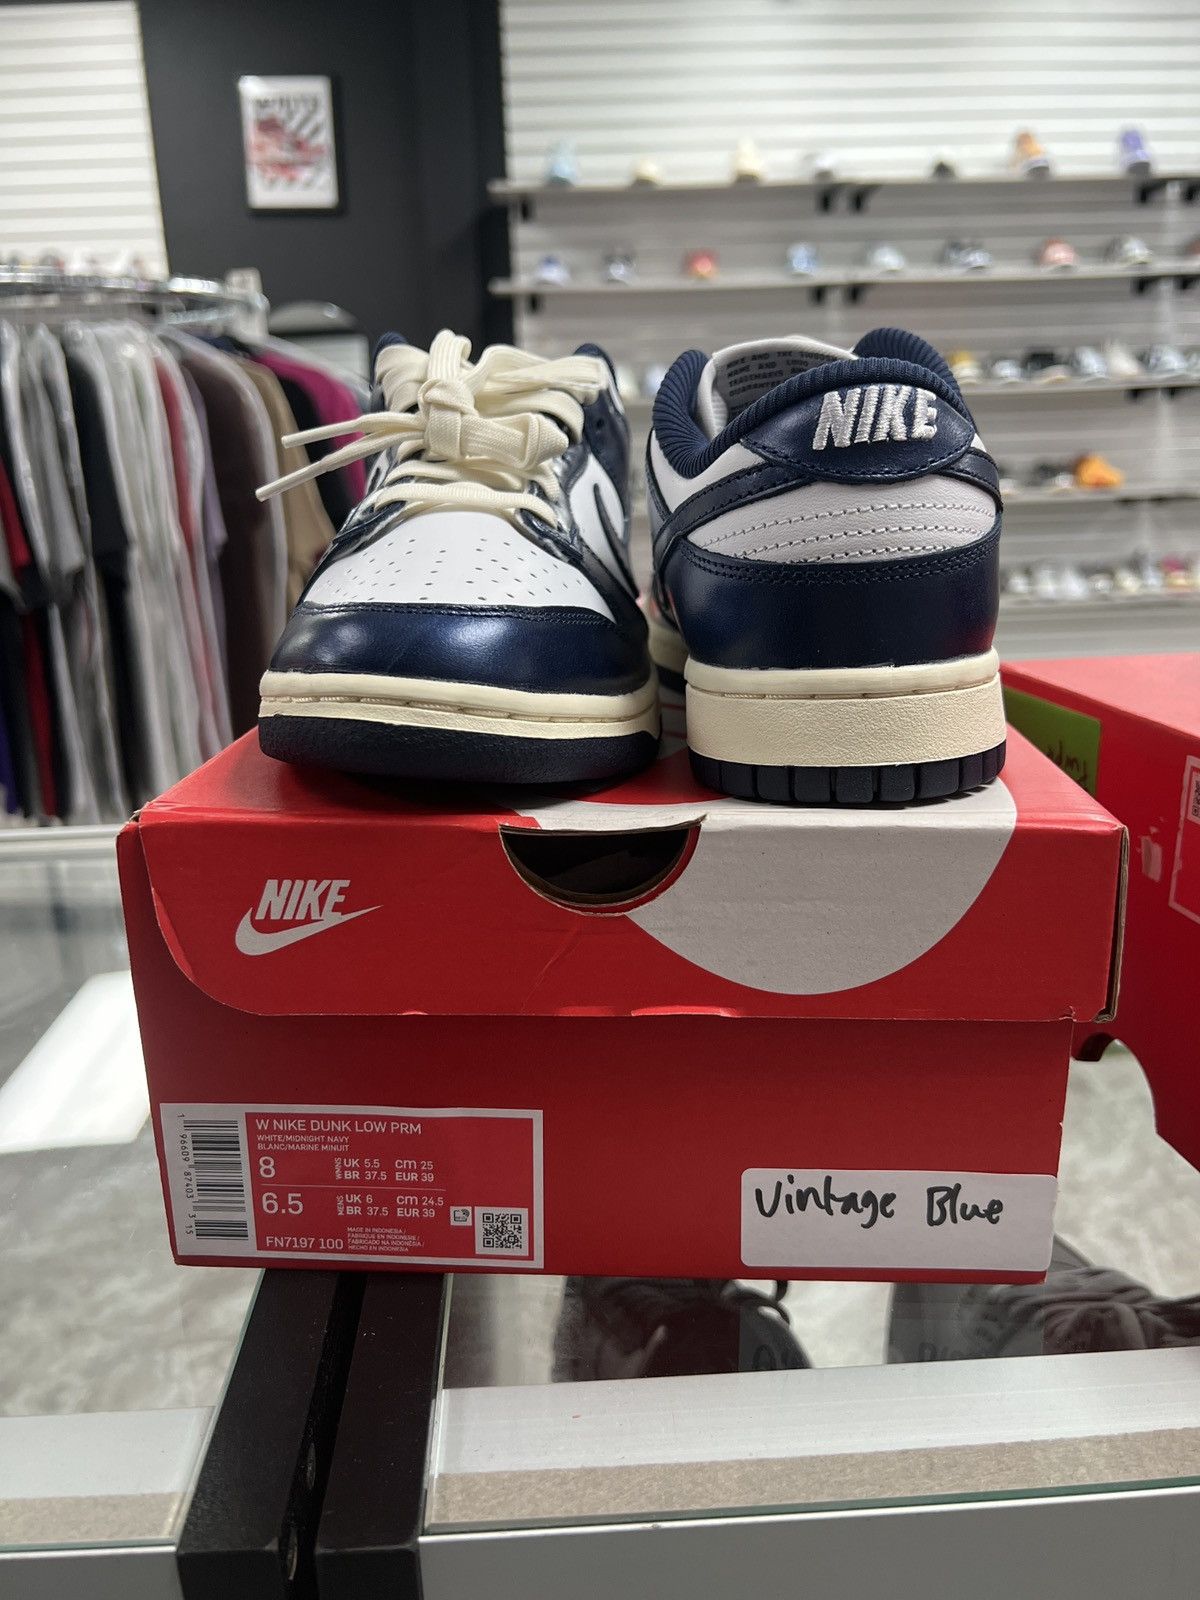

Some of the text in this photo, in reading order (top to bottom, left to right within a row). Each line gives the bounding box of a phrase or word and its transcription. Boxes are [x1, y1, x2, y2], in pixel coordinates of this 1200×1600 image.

[812, 383, 938, 451] NIKE
[255, 879, 351, 921] NIKE
[256, 1118, 422, 1135] W NIKE DUNK LOW PRM
[180, 1133, 190, 1162] 96609
[257, 1134, 350, 1144] WHITE/MIDNIGHT NAVY
[257, 1143, 350, 1152] BLANC/MARINE MINUIT
[259, 1156, 276, 1178] 8
[344, 1158, 360, 1168] UK
[364, 1158, 380, 1169] 5.5
[420, 1160, 434, 1170] 25
[344, 1170, 435, 1182] BR 37.5 EUR 39
[184, 1171, 194, 1199] 87403
[262, 1192, 304, 1215] 6.5
[345, 1194, 361, 1204] UK
[366, 1194, 373, 1204] 6
[421, 1196, 444, 1206] 24.5
[755, 1174, 1004, 1229] Vintage Blue
[346, 1206, 436, 1218] BR 37.5 EUR 39
[266, 1236, 344, 1250] FN7197 100
